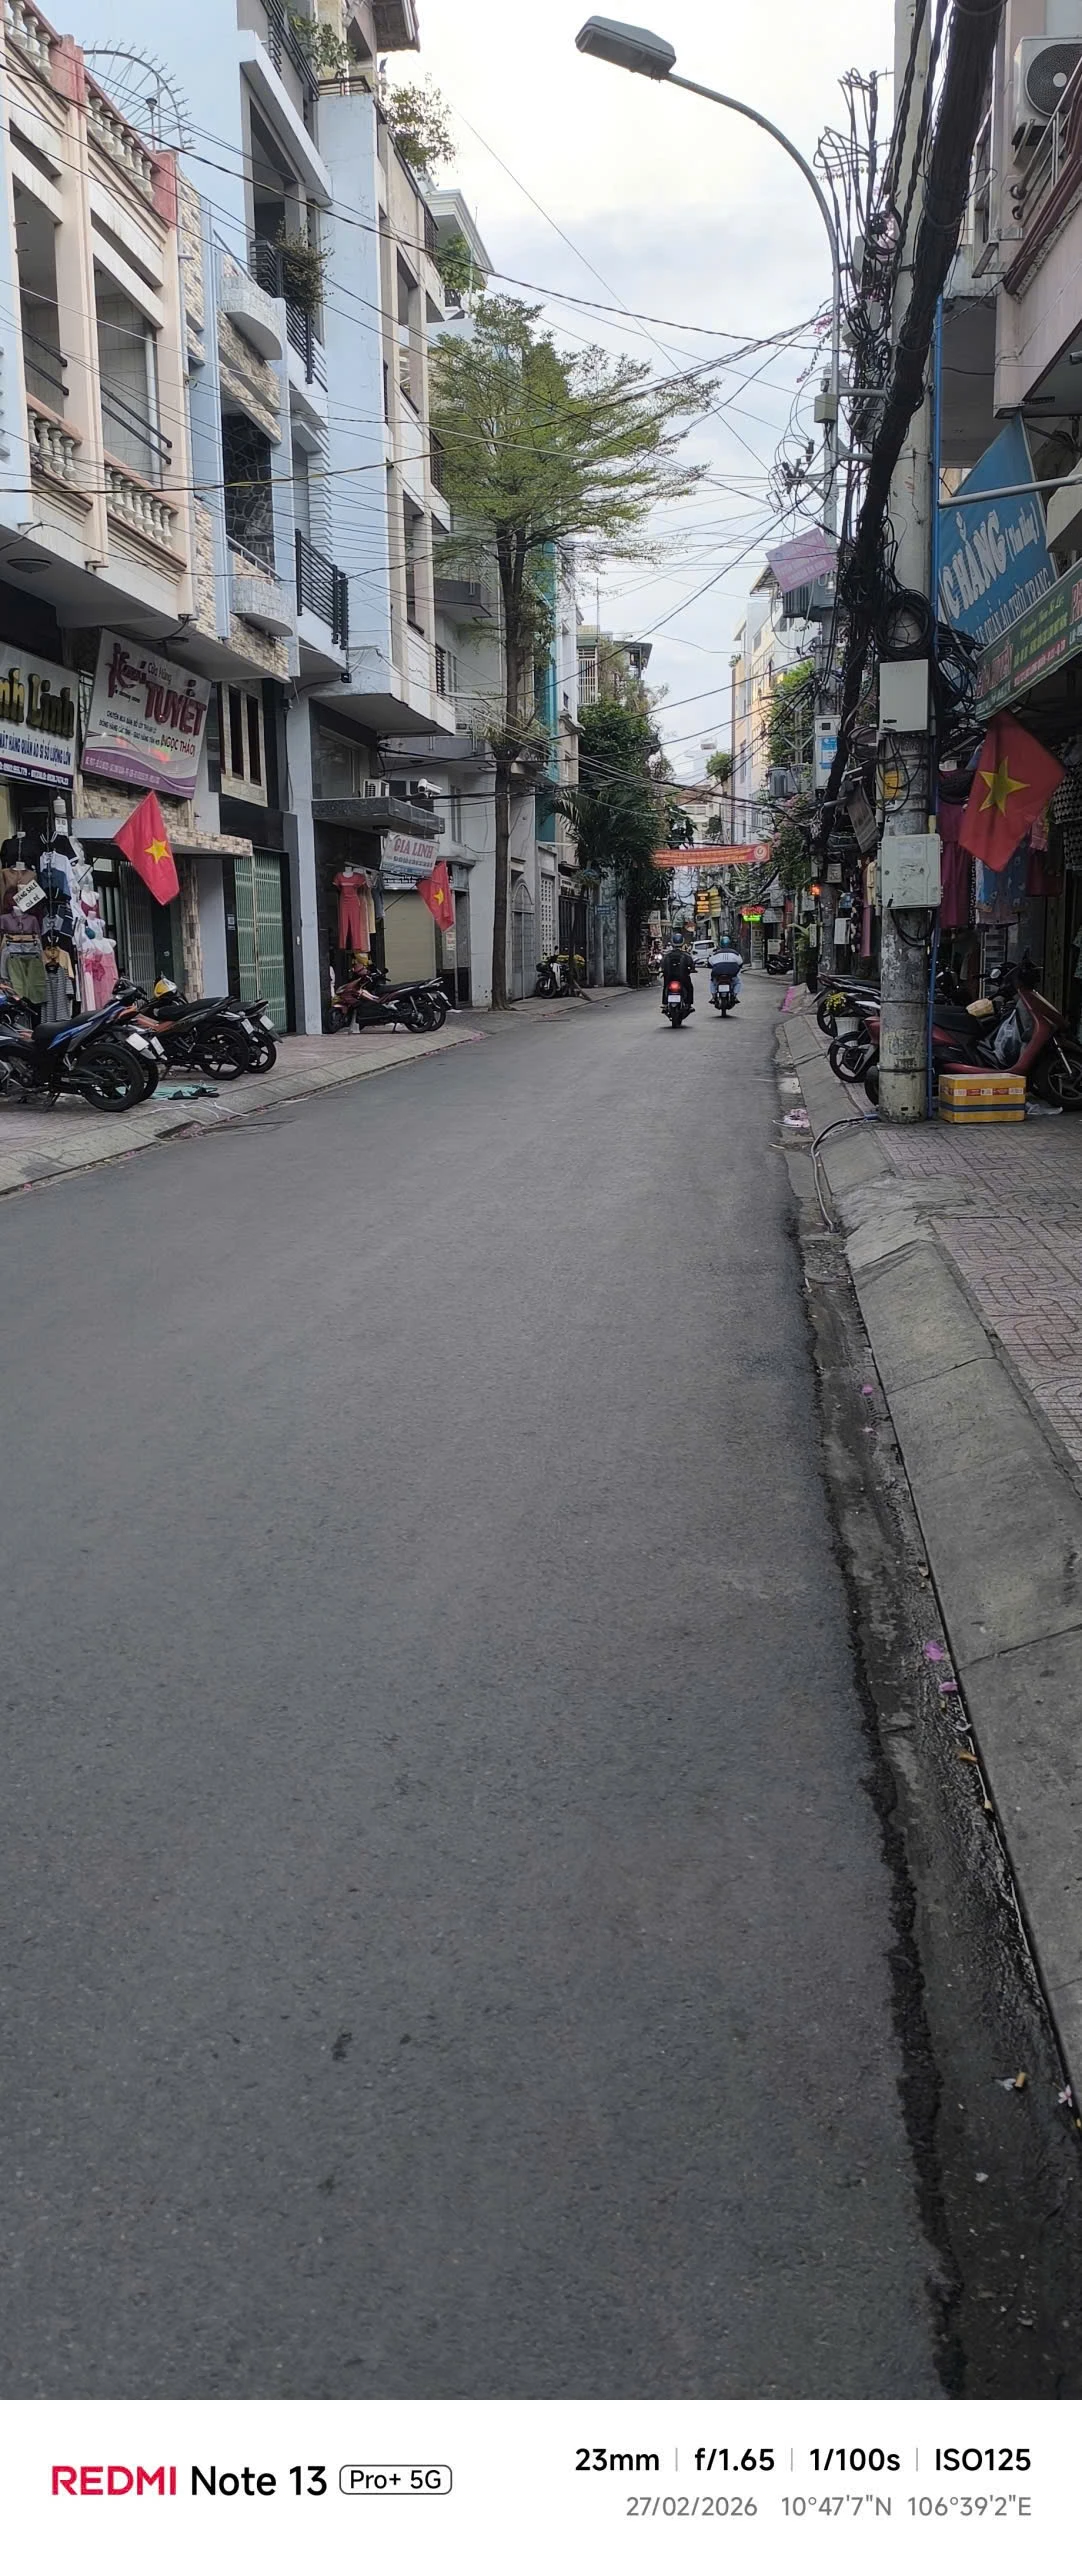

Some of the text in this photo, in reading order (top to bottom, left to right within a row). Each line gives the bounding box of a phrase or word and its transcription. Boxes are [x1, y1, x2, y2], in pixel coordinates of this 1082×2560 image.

[26, 673, 75, 738] Linh
[144, 679, 208, 736] TUYẾT
[393, 837, 434, 860] GIA LINH
[26, 881, 38, 894] SALE
